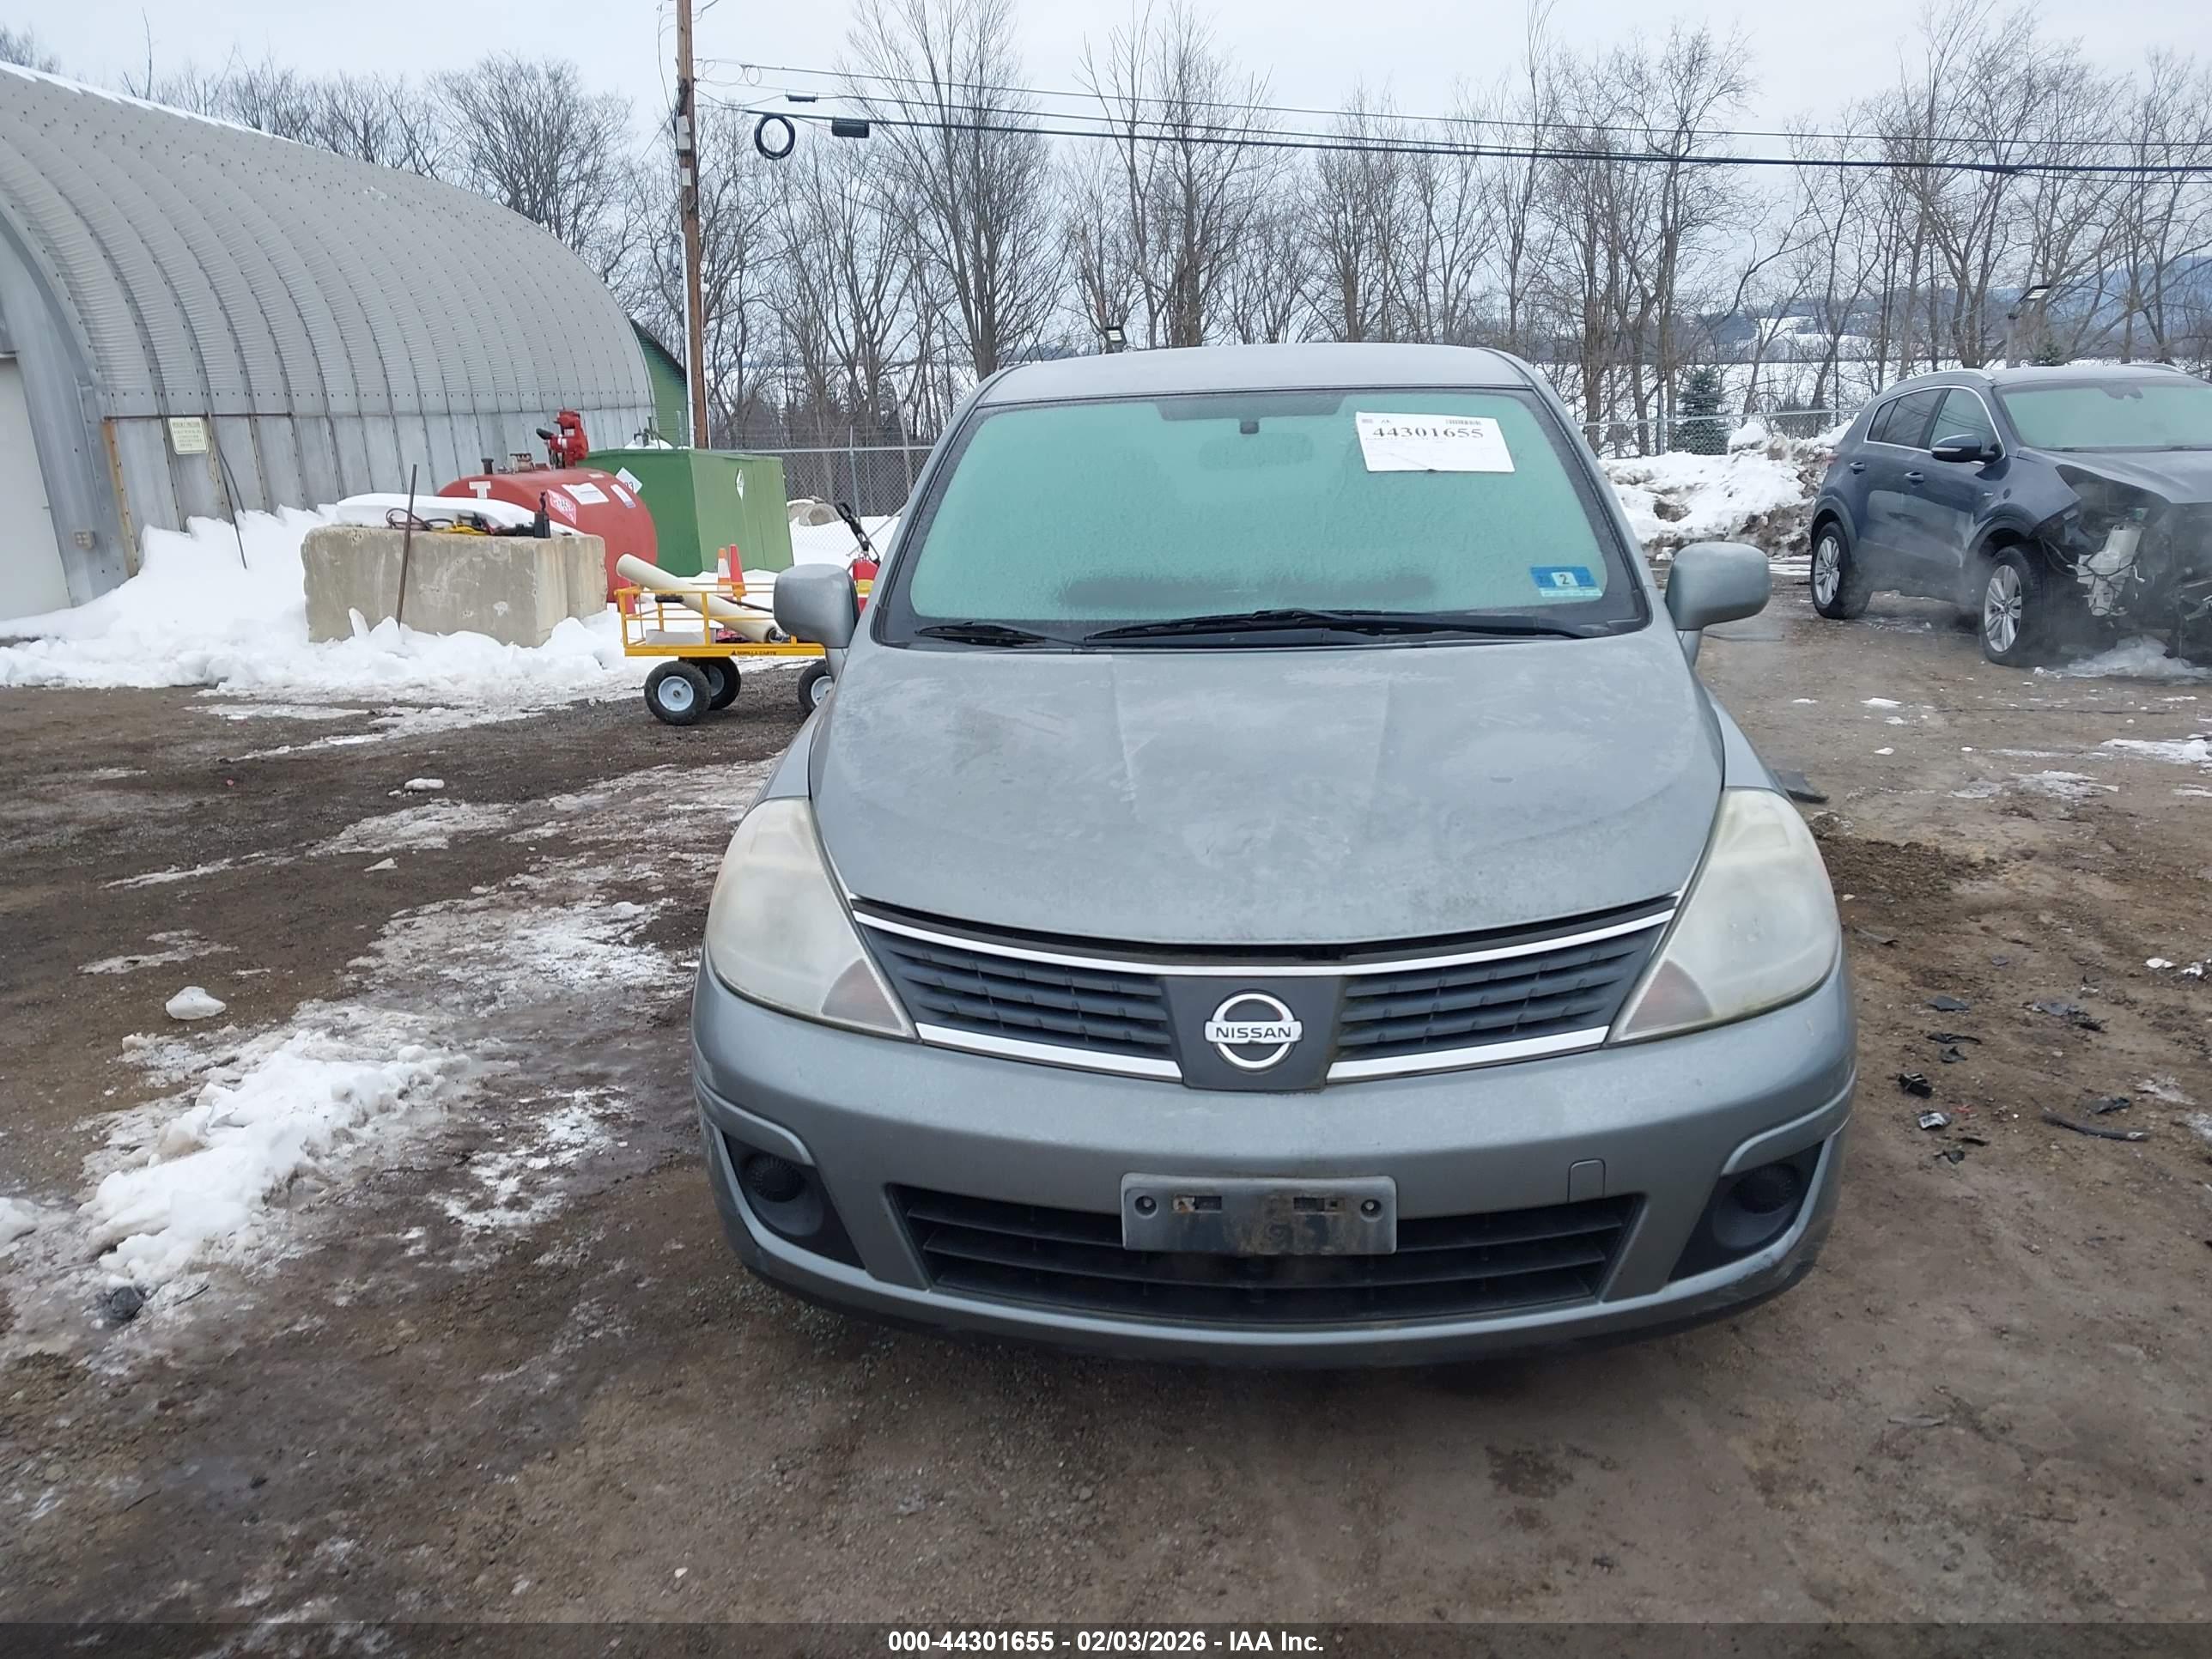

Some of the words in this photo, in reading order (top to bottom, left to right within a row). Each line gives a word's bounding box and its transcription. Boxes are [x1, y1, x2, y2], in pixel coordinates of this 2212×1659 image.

[1373, 427, 1484, 439] 44301655
[1559, 574, 1570, 585] 2
[1216, 1027, 1291, 1039] NISSAN
